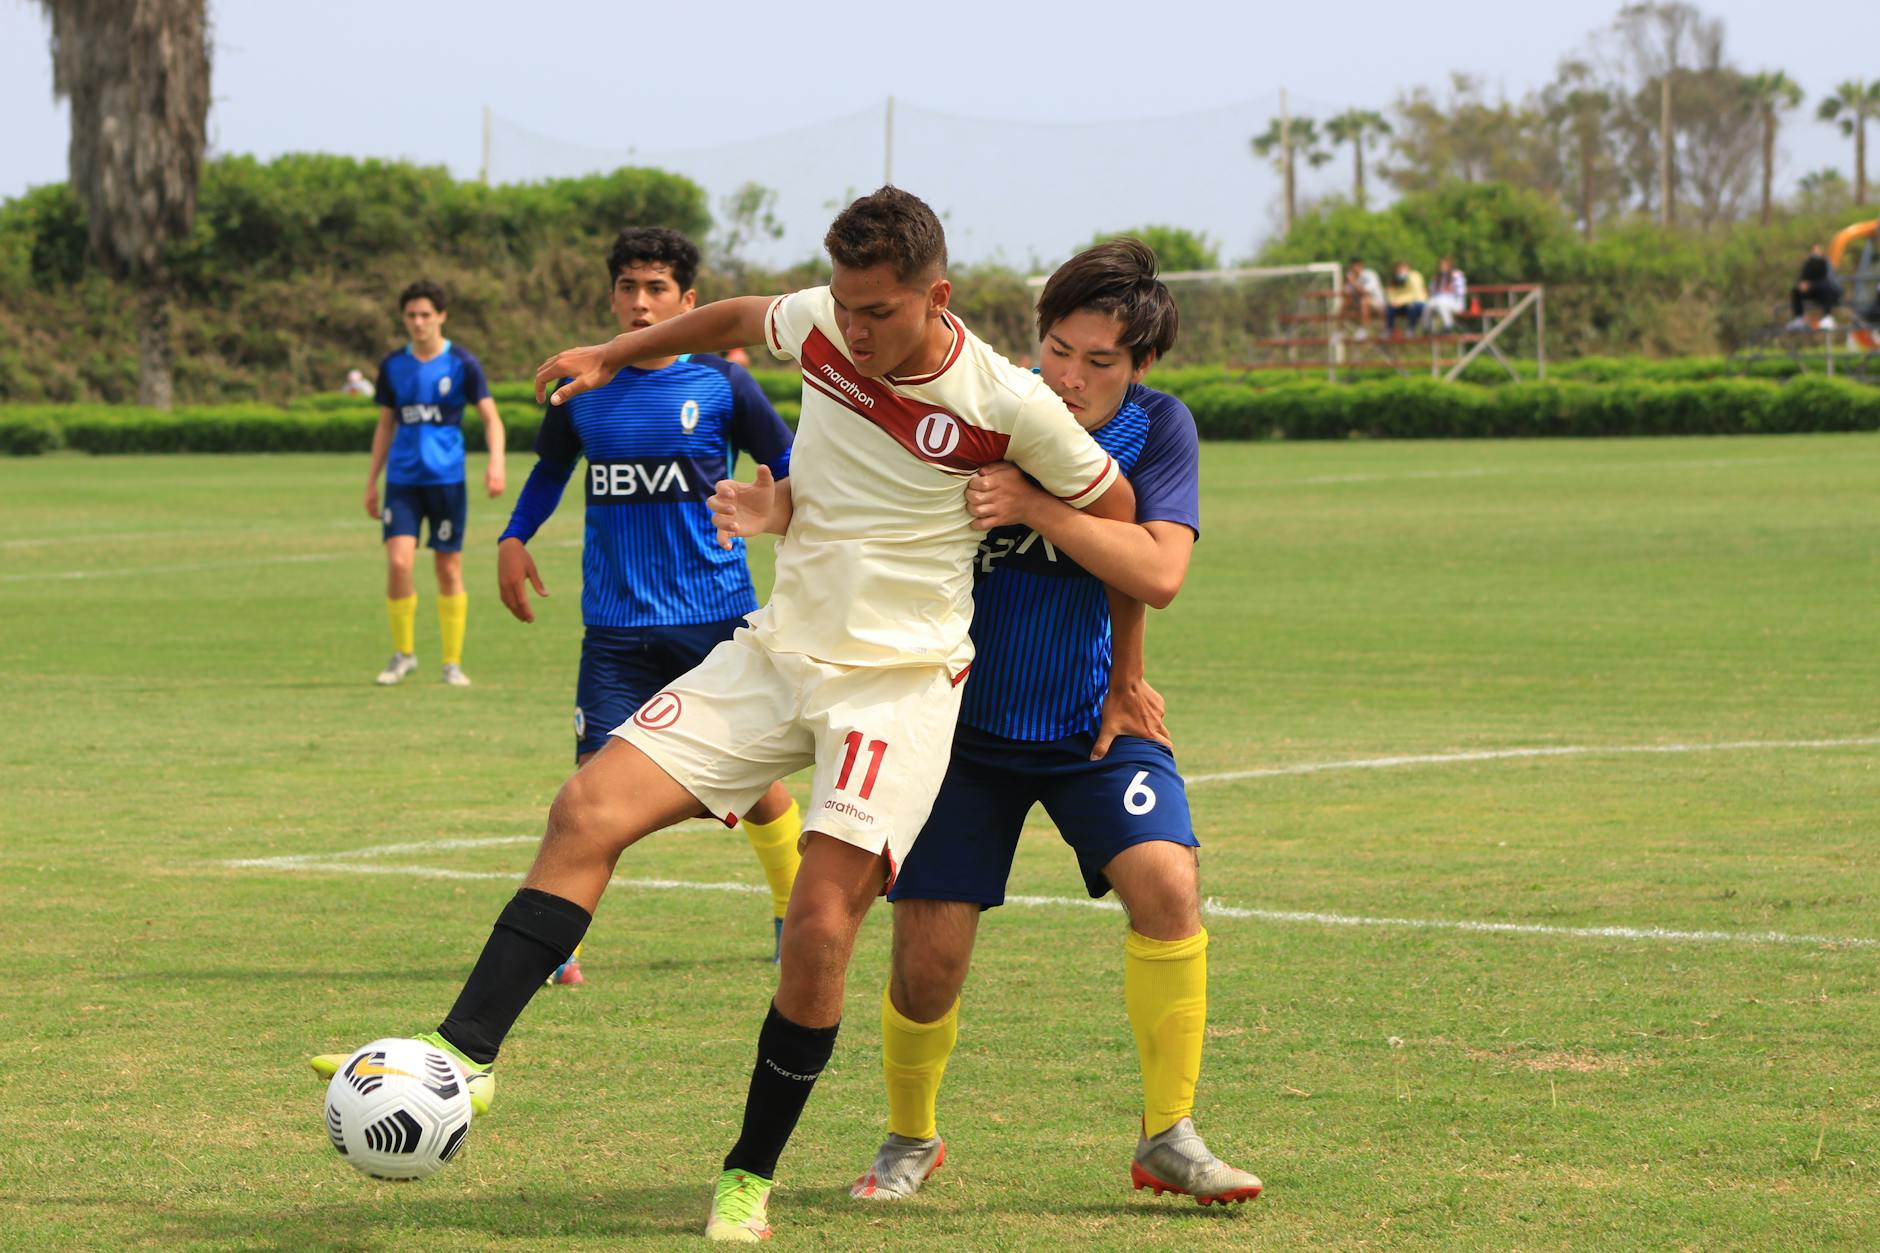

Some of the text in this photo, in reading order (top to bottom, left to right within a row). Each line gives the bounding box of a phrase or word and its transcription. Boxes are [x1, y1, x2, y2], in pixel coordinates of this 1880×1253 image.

[820, 363, 875, 409] marathon
[922, 417, 954, 454] U
[590, 461, 690, 496] BBVA
[437, 519, 452, 541] 8
[835, 730, 888, 800] 11
[1123, 770, 1156, 816] 6
[824, 800, 874, 824] arathon
[766, 1058, 820, 1081] marath
